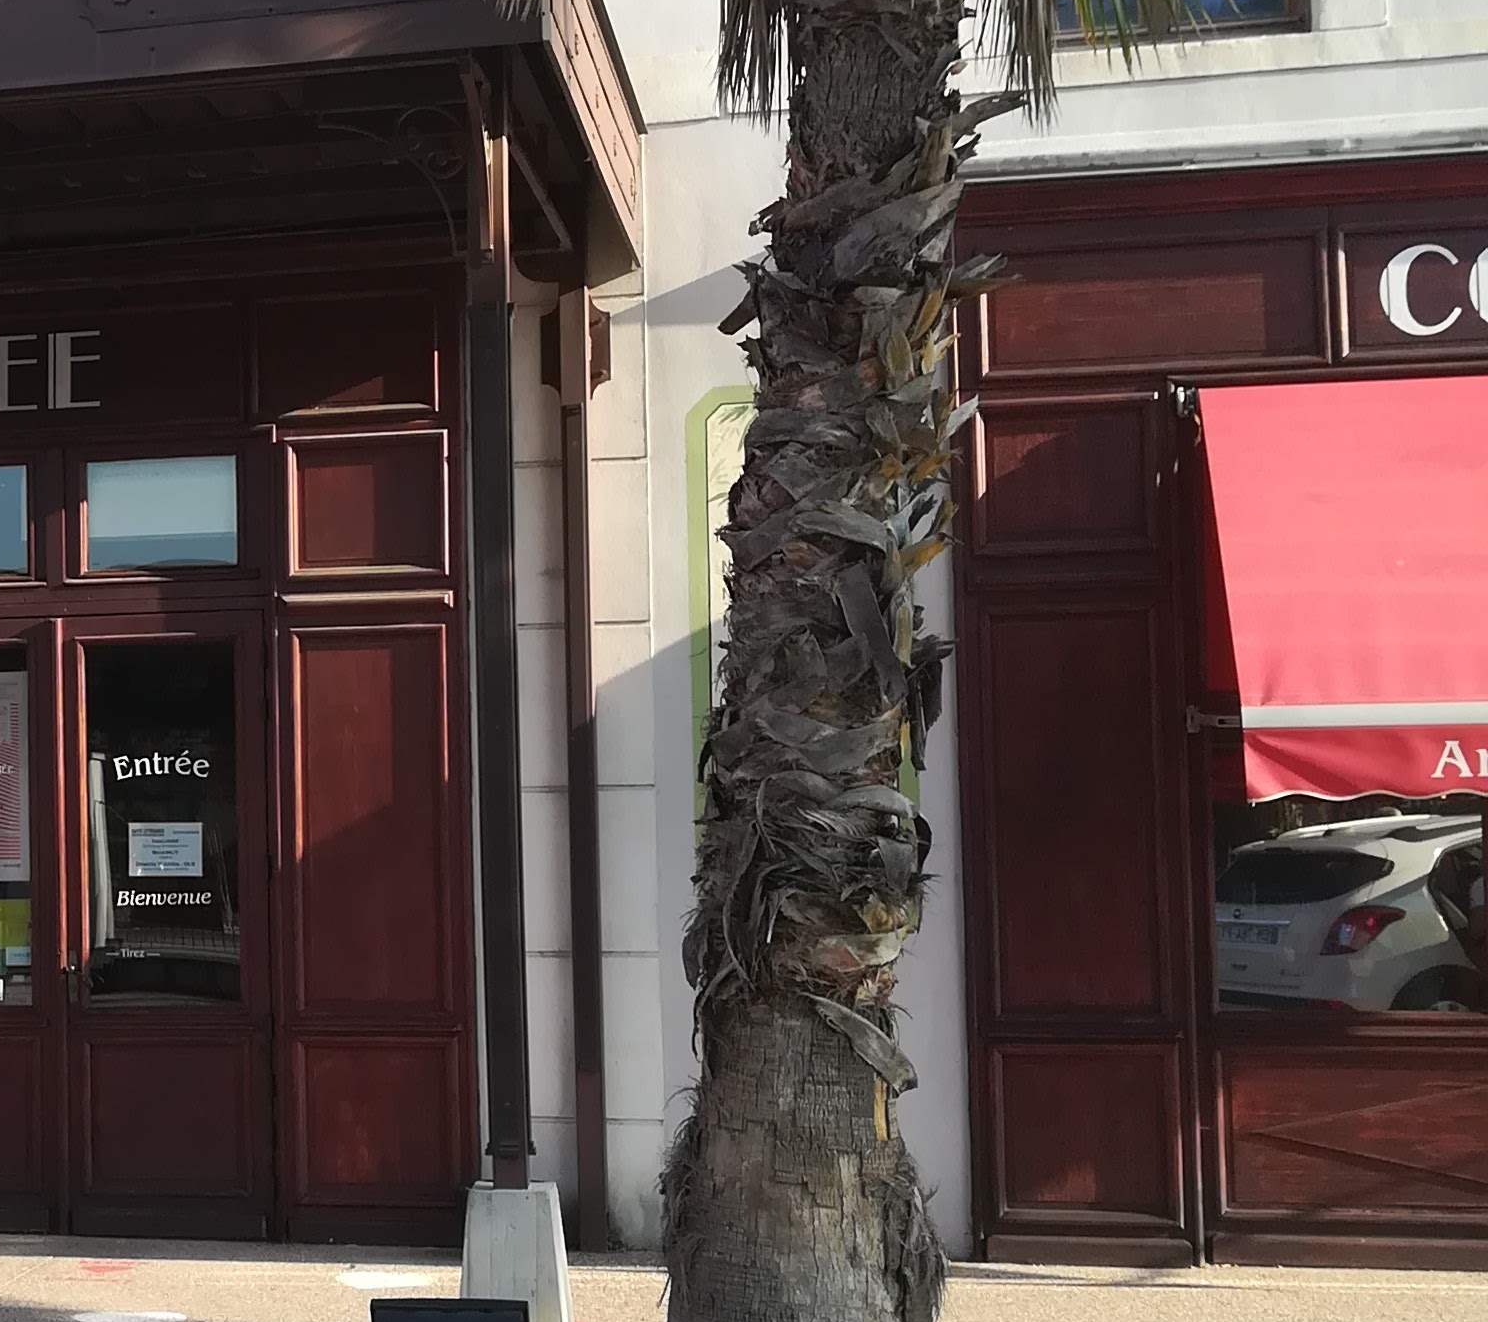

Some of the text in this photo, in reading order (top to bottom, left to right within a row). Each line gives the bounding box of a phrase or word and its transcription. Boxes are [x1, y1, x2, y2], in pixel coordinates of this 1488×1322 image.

[113, 749, 210, 780] Entrée
[117, 889, 212, 907] Bienvenue
[121, 948, 146, 958] Tirez
